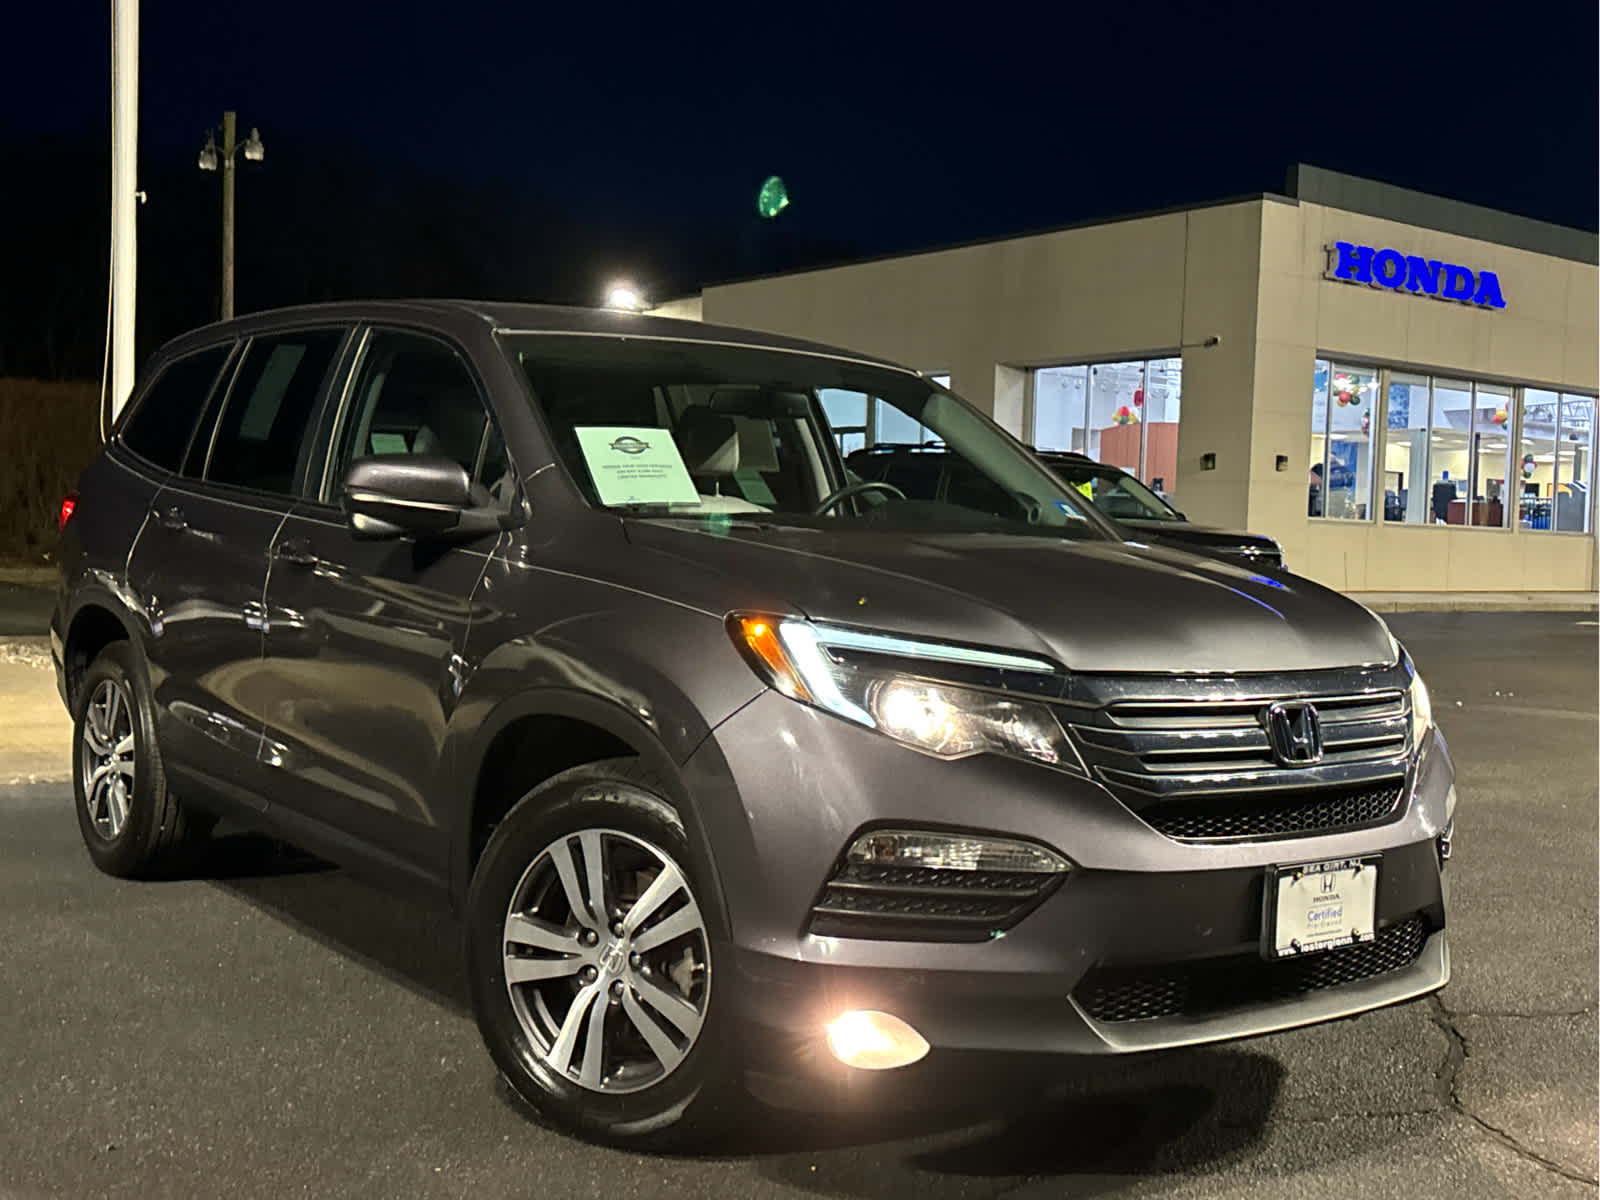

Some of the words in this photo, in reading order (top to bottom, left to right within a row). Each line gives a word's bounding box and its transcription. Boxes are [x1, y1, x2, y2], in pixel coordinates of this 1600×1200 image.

[1334, 241, 1507, 309] HONDA
[1313, 893, 1340, 903] HONDA
[1307, 906, 1343, 921] Certified
